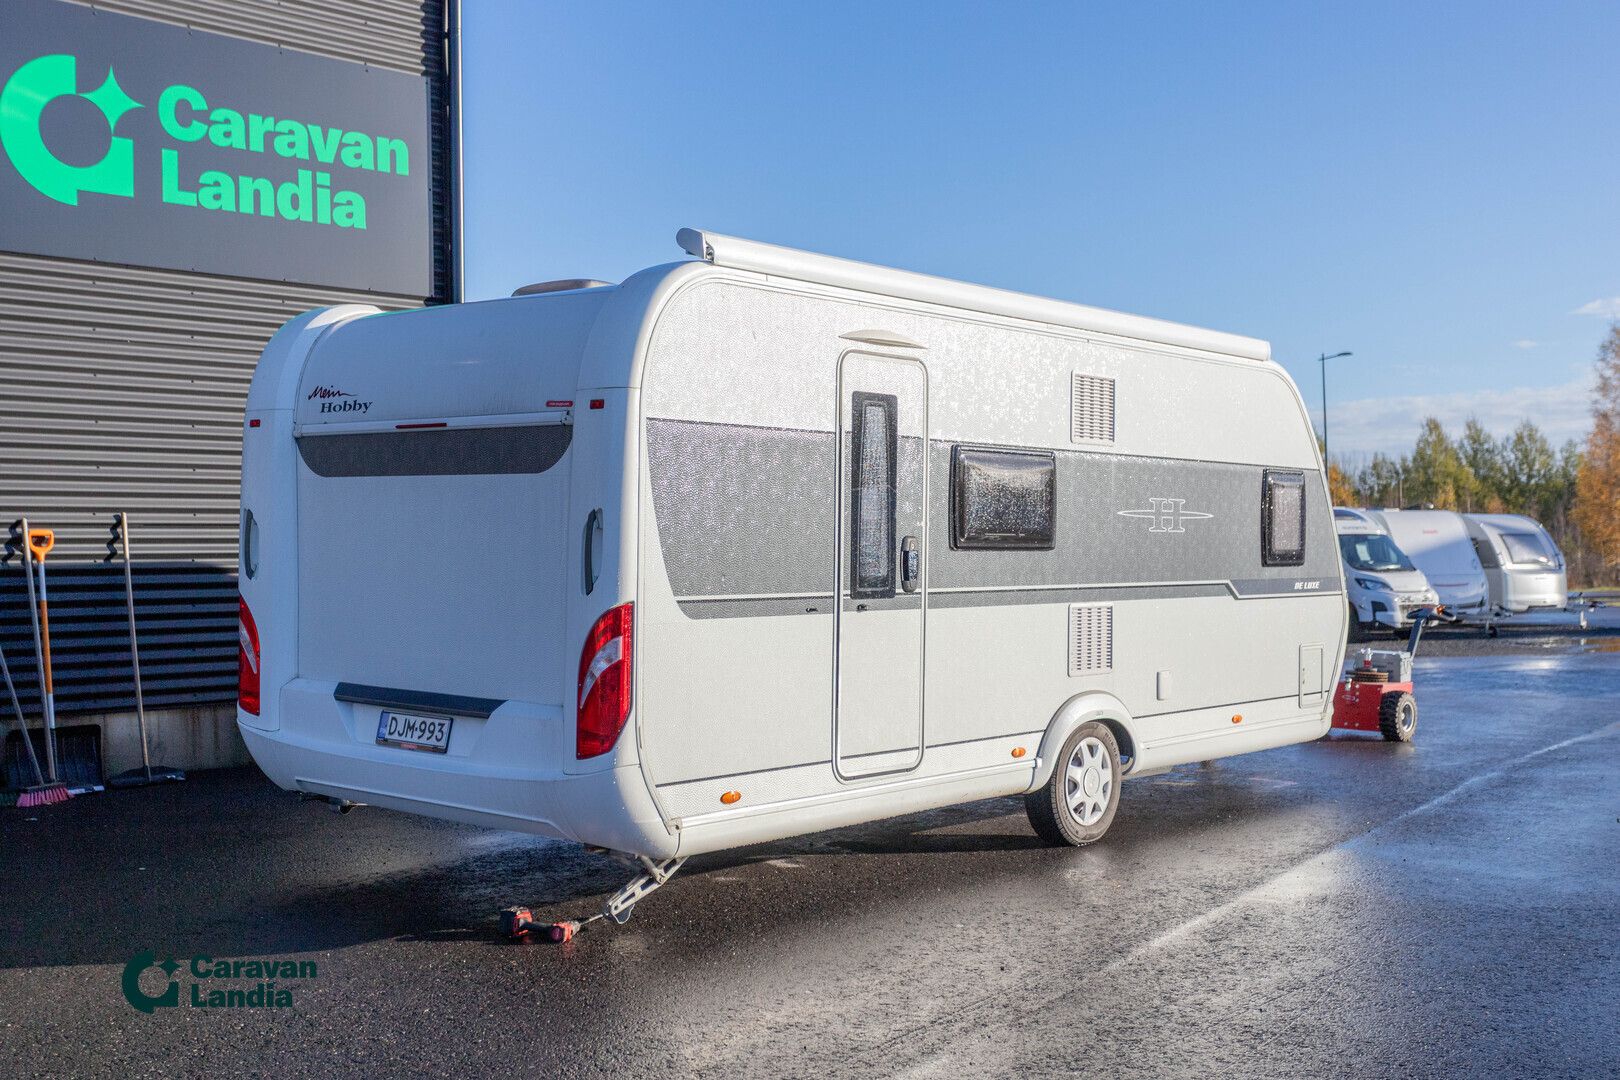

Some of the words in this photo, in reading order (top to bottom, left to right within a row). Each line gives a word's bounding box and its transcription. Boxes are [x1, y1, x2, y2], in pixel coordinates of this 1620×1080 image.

[157, 84, 409, 176] Caravan
[161, 148, 367, 230] Landia
[308, 385, 359, 401] Mein
[320, 400, 373, 414] Hobby
[1294, 582, 1303, 590] DE
[1303, 581, 1320, 590] LUXE
[388, 716, 446, 742] DJM-993
